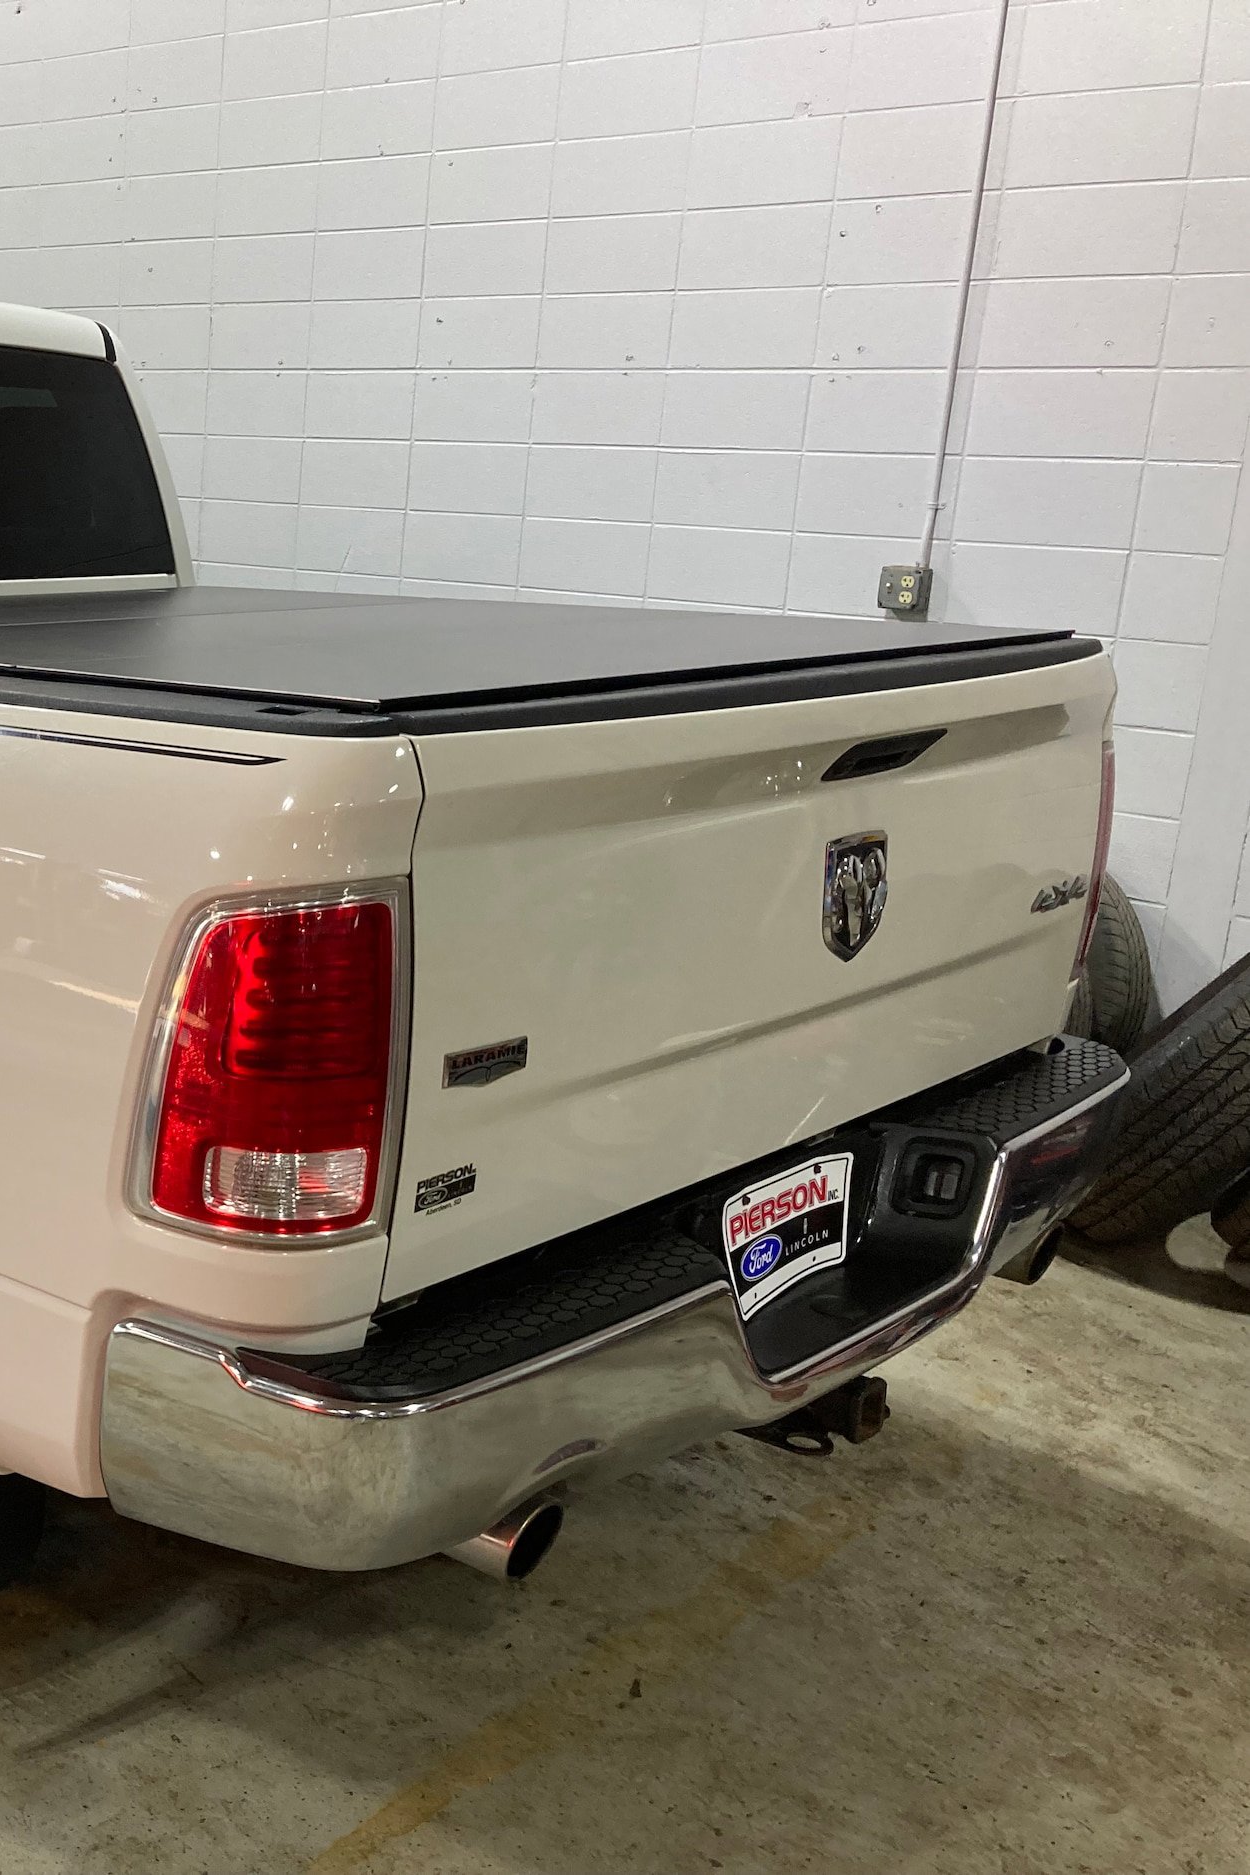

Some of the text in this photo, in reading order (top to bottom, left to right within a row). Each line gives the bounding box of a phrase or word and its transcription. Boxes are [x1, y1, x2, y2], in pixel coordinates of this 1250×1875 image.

[451, 1043, 527, 1070] LARAMIE
[417, 1163, 473, 1193] PIERSON
[729, 1175, 828, 1247] PIERSON
[785, 1229, 829, 1256] LINCOLN
[749, 1243, 773, 1274] Ford
